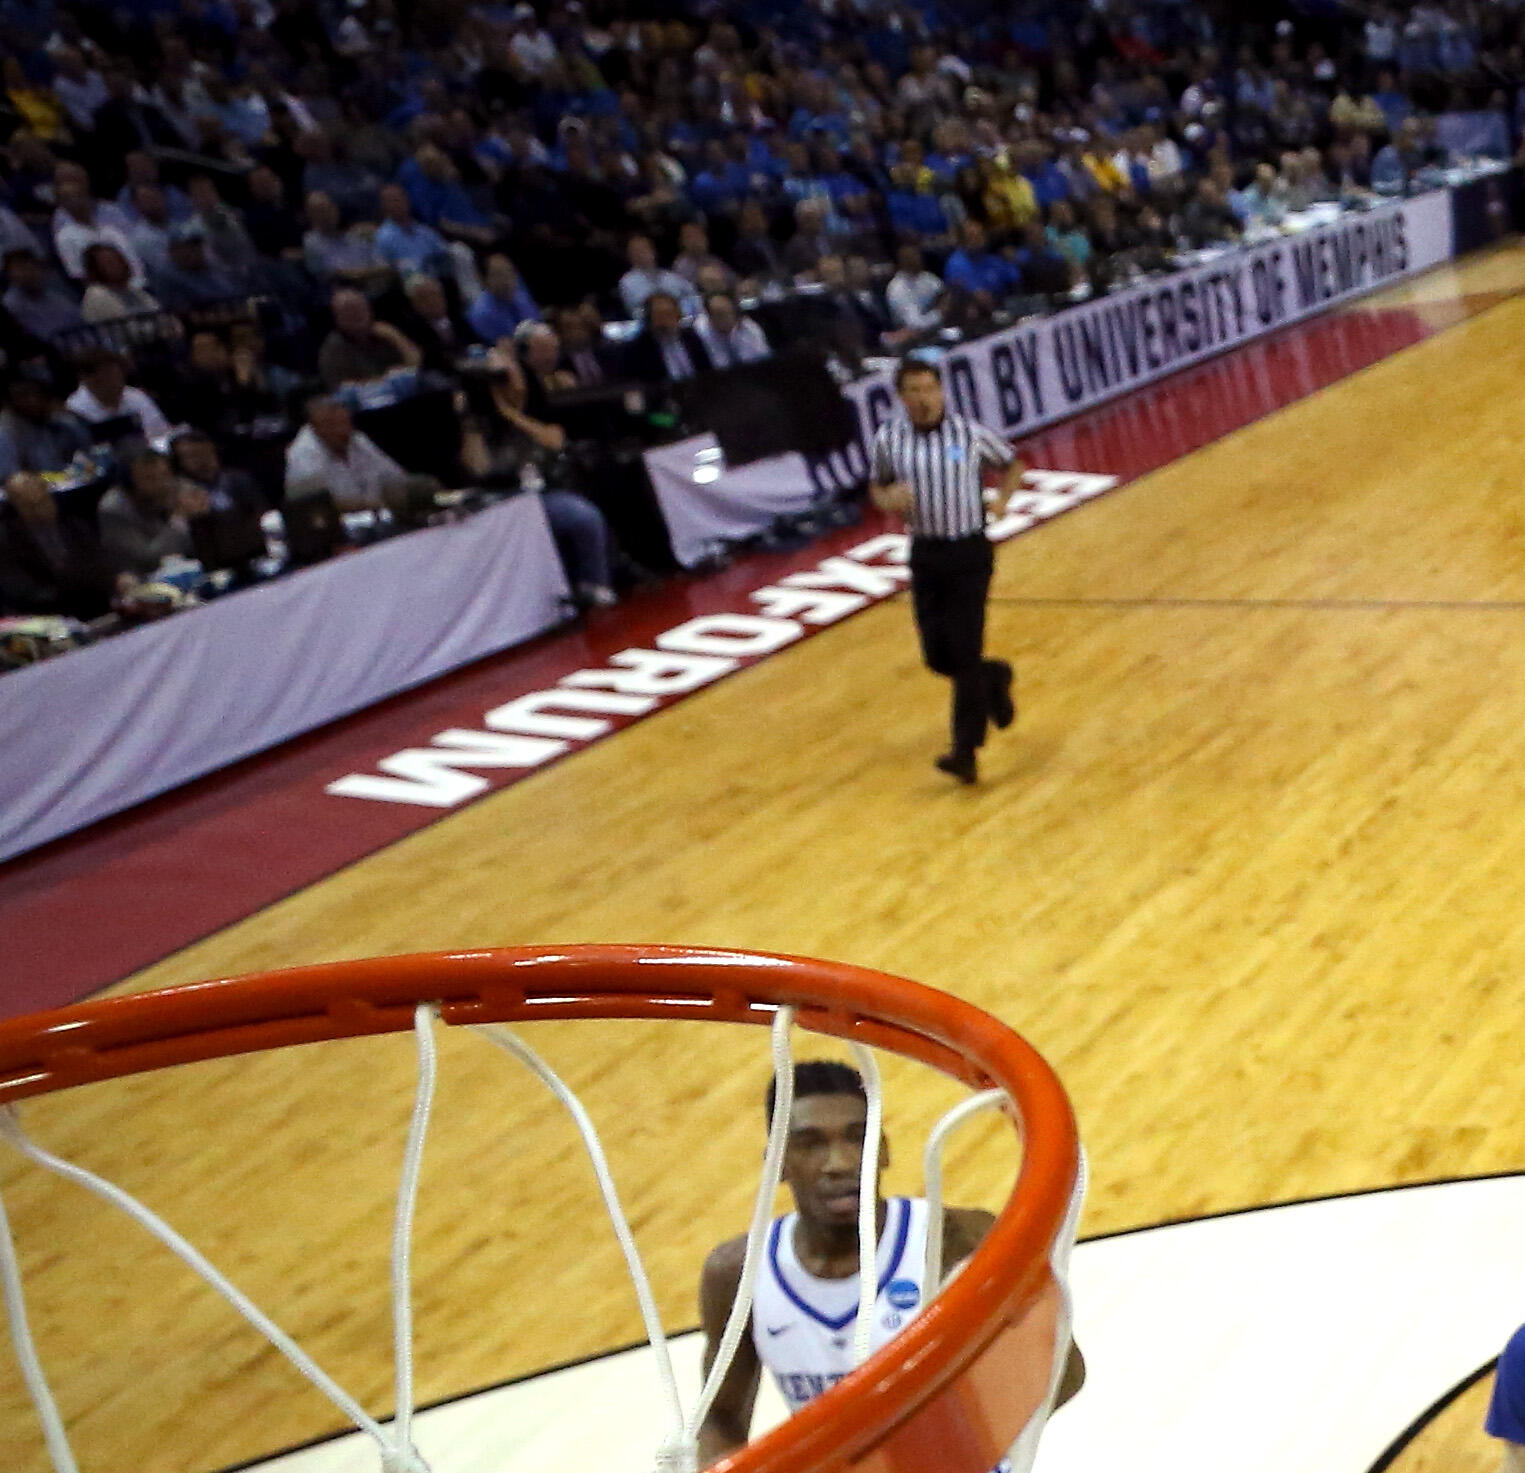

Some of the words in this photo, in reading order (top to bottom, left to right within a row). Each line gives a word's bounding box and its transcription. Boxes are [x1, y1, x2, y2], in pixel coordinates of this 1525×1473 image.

[992, 332, 1044, 426] BY
[1053, 265, 1243, 400] UNIVERSITY
[1252, 250, 1286, 325] OF
[1292, 211, 1408, 304] MEMPHIS
